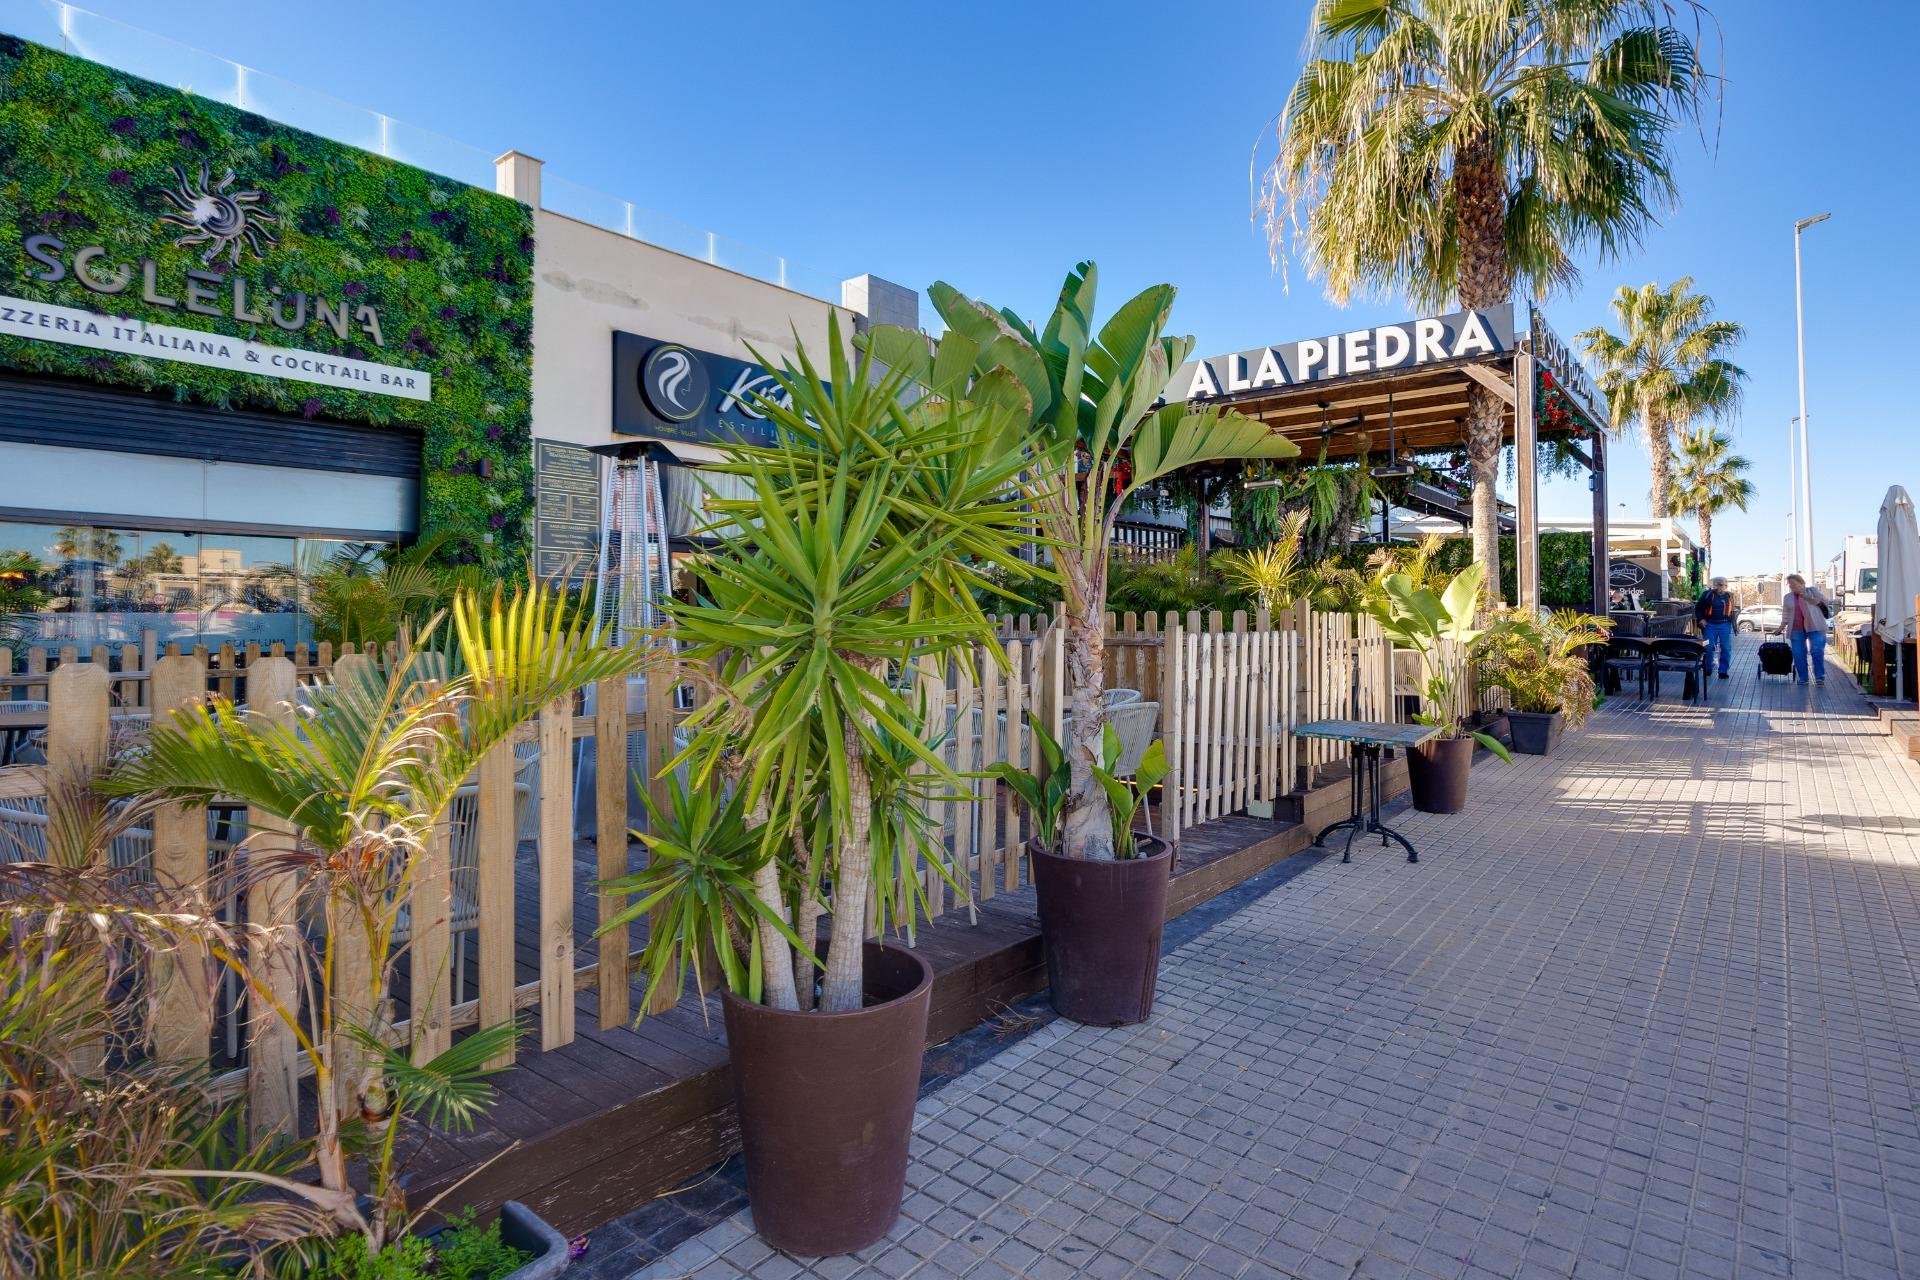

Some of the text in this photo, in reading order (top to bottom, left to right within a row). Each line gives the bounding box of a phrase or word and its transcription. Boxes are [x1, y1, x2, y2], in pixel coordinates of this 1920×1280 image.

[24, 235, 385, 346] SOLELUNA
[113, 326, 231, 358] ITALIANA
[244, 350, 260, 363] &
[271, 354, 372, 382] COCKTAIL
[380, 373, 416, 389] BAR
[1228, 346, 1288, 392] LA
[1298, 309, 1496, 380] PIEDRA
